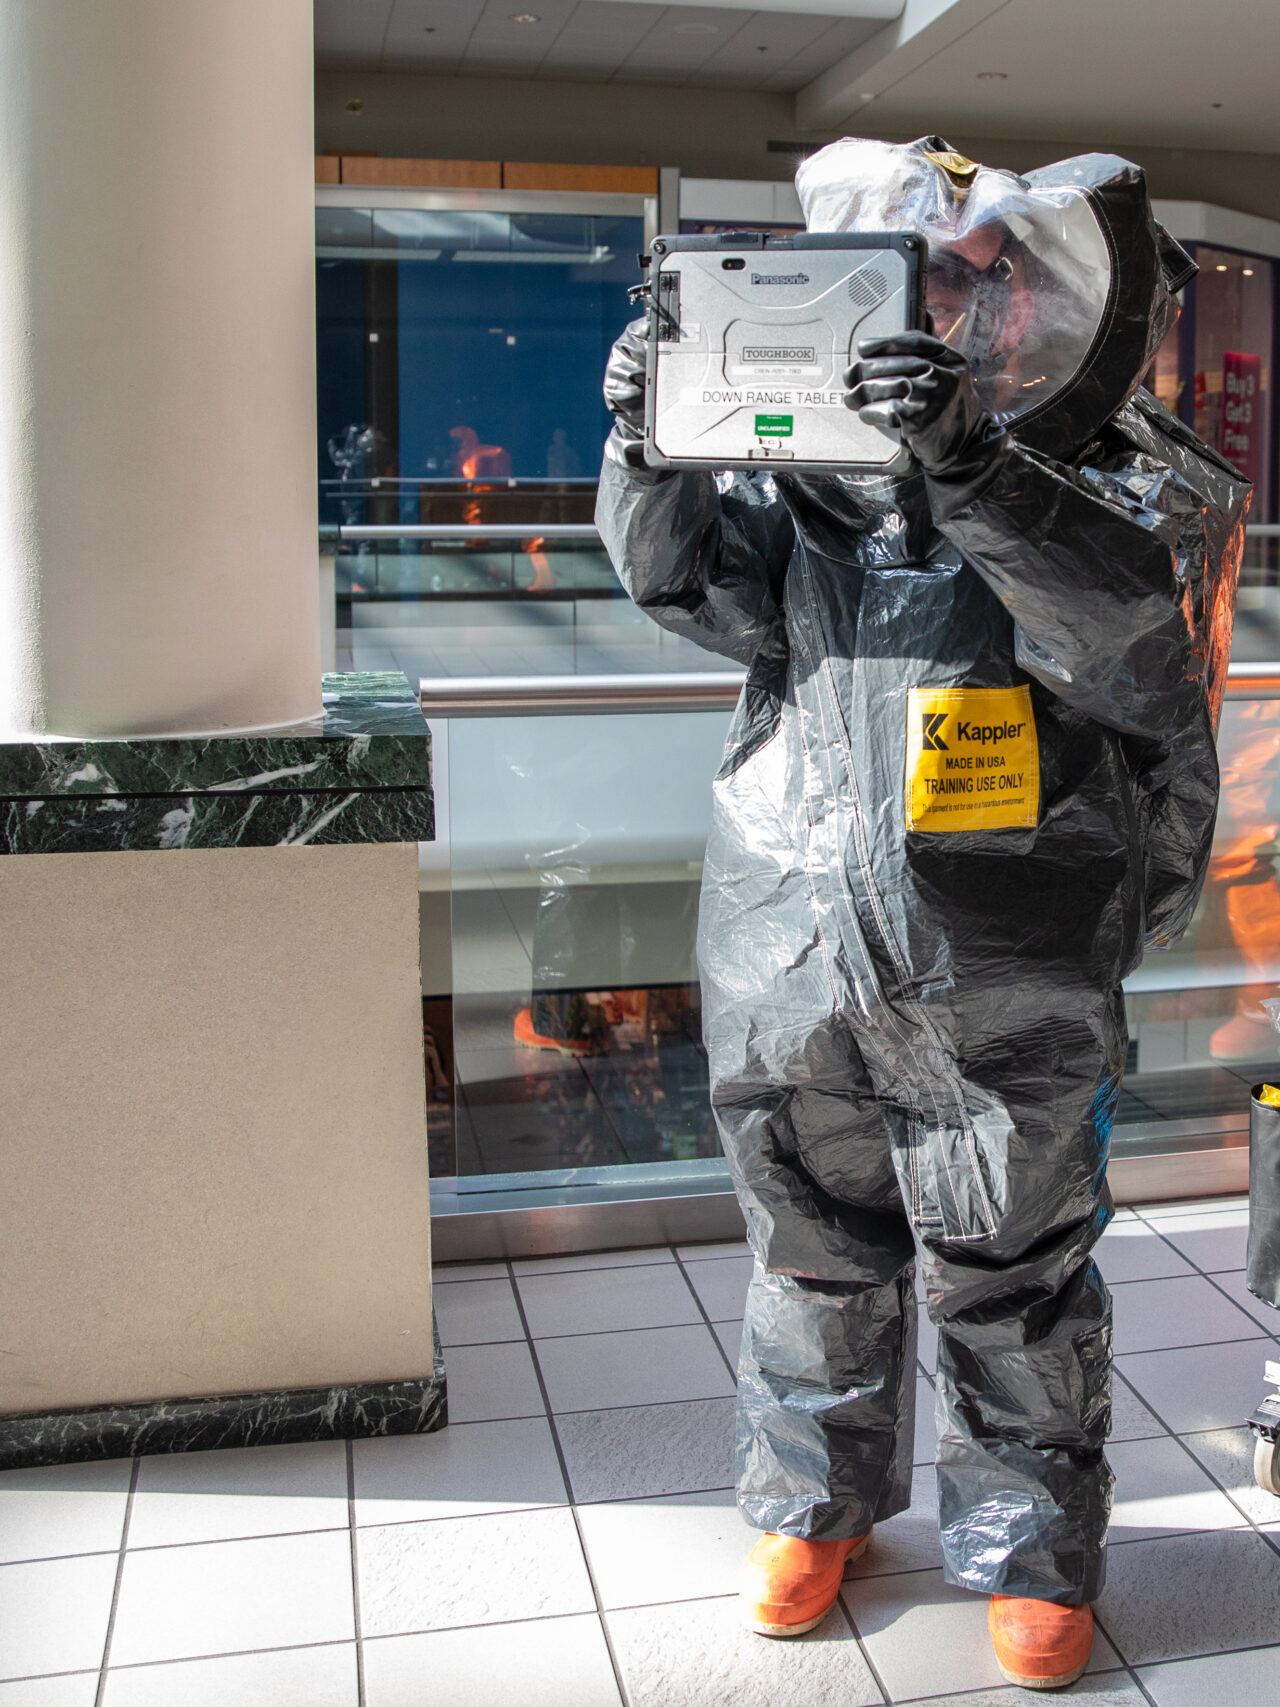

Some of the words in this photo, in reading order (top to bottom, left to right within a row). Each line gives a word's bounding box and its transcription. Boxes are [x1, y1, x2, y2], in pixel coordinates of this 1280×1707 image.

[751, 273, 810, 285] Panasonic
[746, 350, 811, 358] TOUGHBOOK
[1226, 373, 1246, 398] Buy
[1247, 375, 1254, 396] 3
[702, 391, 742, 403] DOWN
[746, 392, 792, 404] RANGE
[796, 392, 845, 404] TABLET
[1226, 402, 1244, 423] Get
[1244, 403, 1252, 424] 3
[1225, 430, 1249, 451] Free
[958, 721, 1024, 745] Kappler
[946, 758, 973, 770] MADE
[976, 757, 984, 768] IN
[988, 756, 1006, 768] USA
[924, 778, 974, 794] TRAINING
[976, 776, 996, 792] USE
[998, 772, 1024, 790] ONLY
